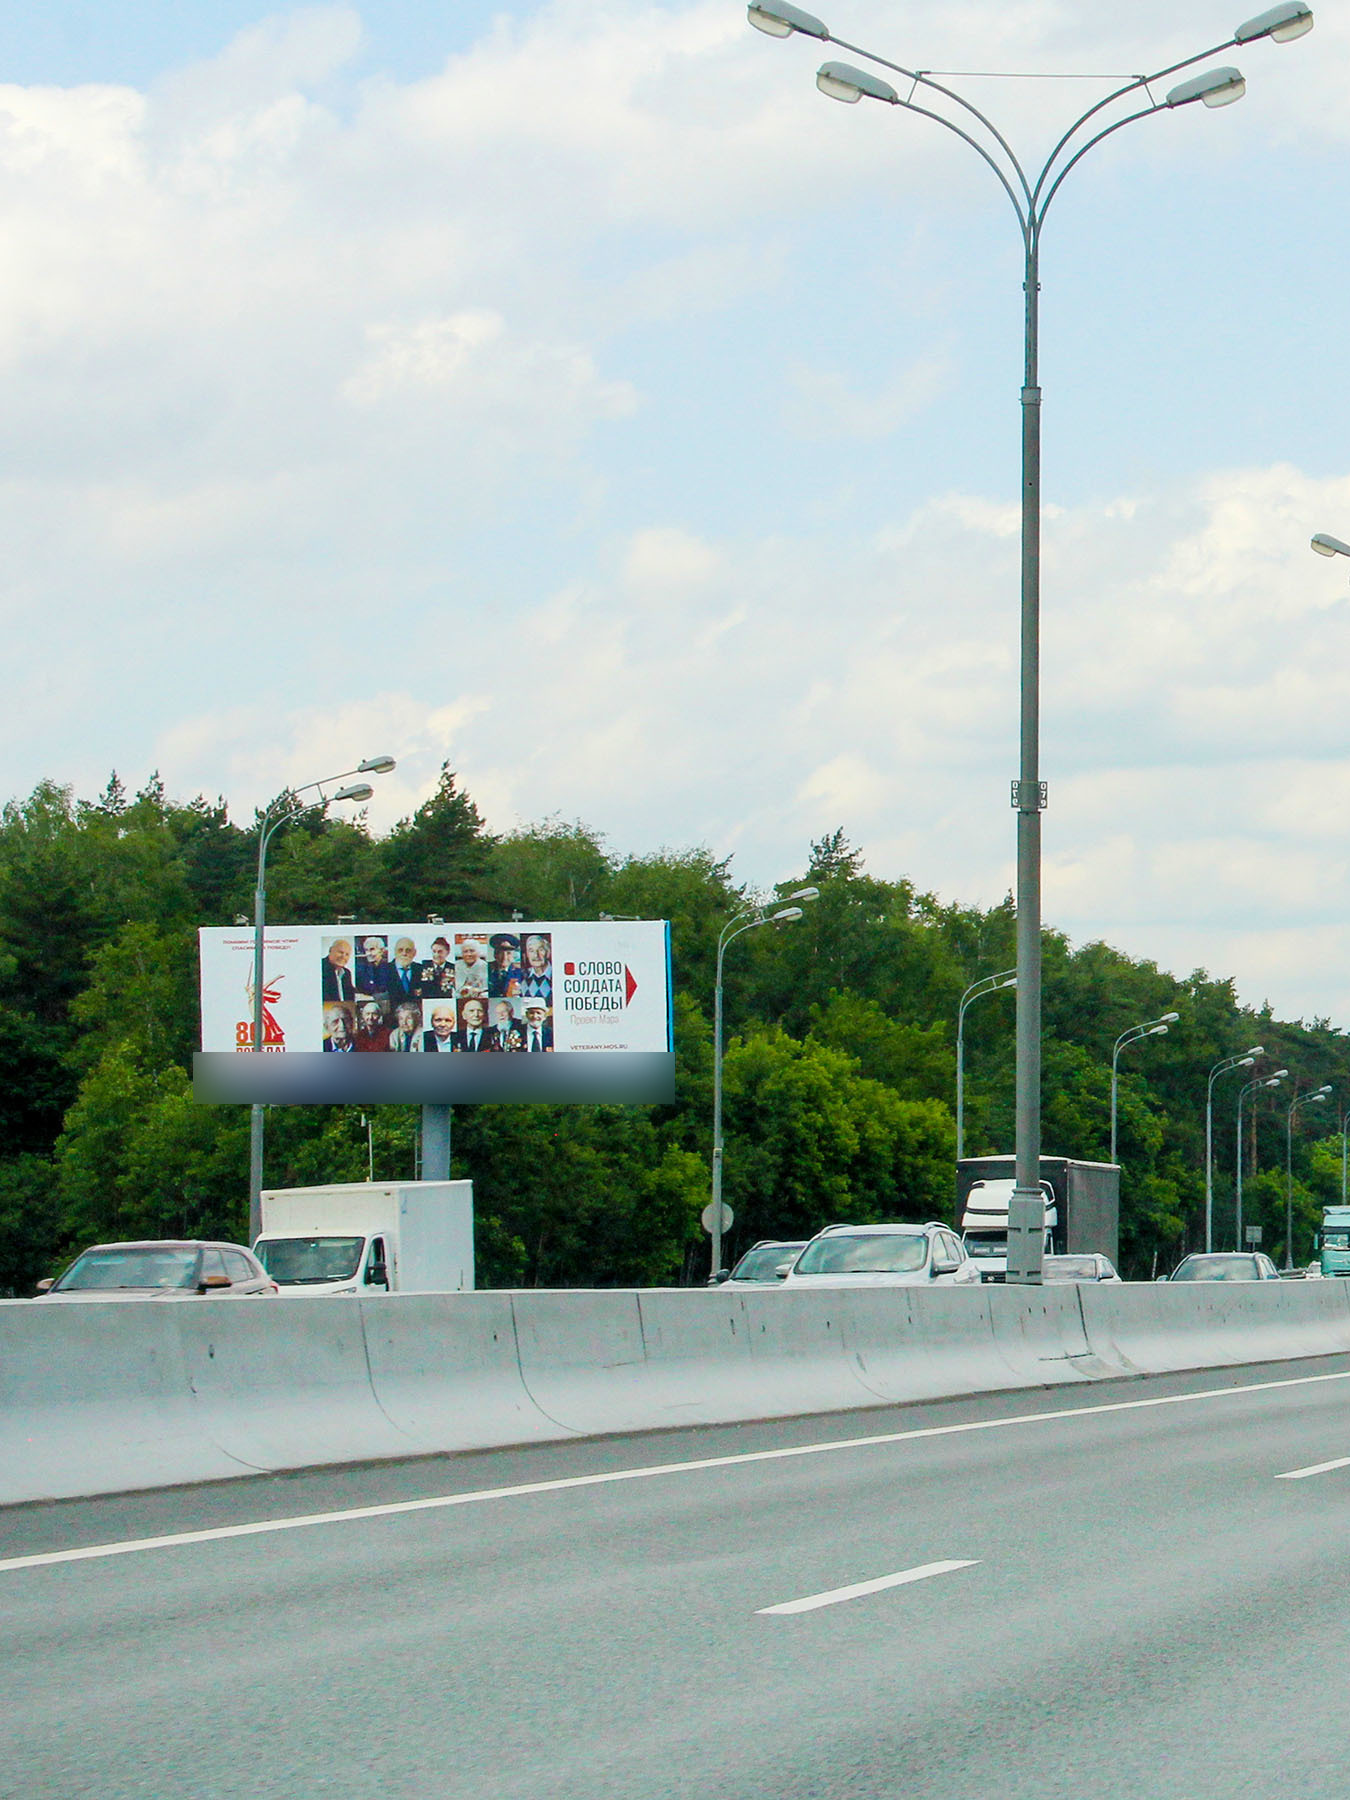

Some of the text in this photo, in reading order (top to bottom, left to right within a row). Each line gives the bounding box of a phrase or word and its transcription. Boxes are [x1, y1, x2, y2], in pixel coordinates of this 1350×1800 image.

[578, 961, 622, 976] СЛОВО
[564, 979, 623, 994] СОЛДАТА
[565, 996, 623, 1012] ПОБЕДЫ
